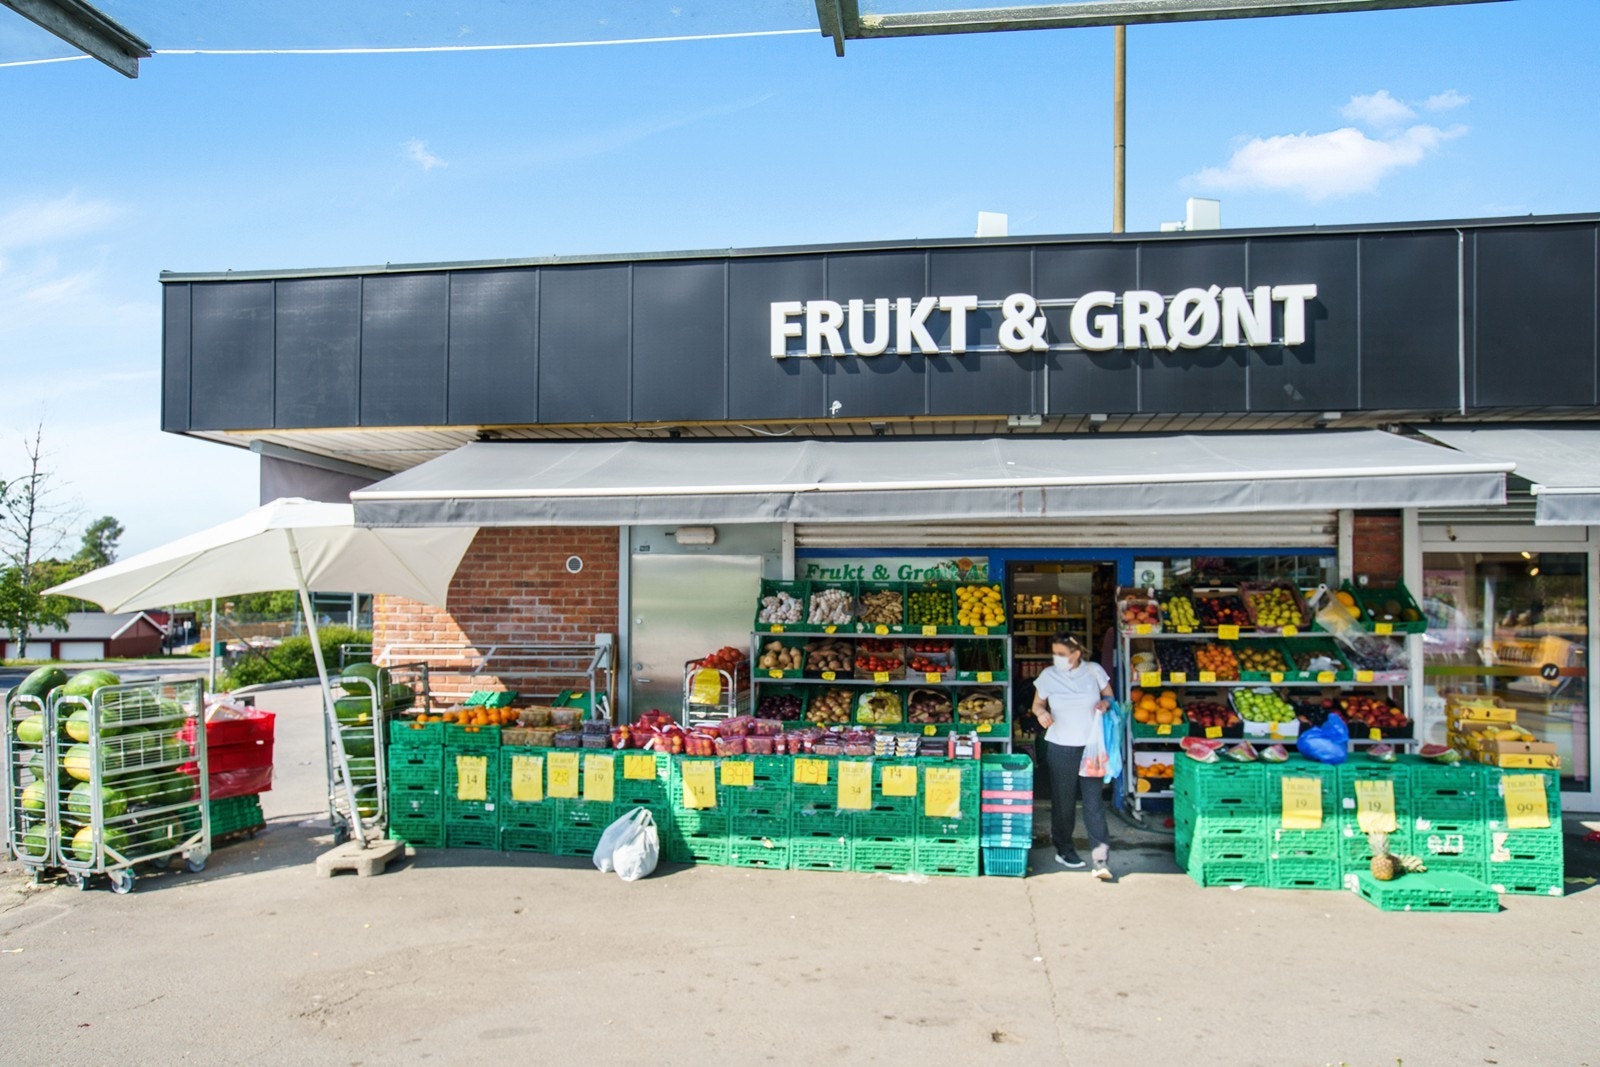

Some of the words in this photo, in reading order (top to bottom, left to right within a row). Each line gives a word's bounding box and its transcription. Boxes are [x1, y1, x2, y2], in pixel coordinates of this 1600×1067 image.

[770, 295, 978, 359] FRUKT
[998, 292, 1050, 354] &
[1069, 284, 1318, 352] GRØNT
[806, 563, 865, 581] Frukt
[872, 564, 890, 581] &
[897, 563, 958, 581] Grønt
[889, 767, 902, 778] 14
[466, 774, 478, 785] 14
[693, 785, 705, 796] 14
[1295, 798, 1308, 808] 19
[1367, 801, 1382, 812] 19
[1516, 802, 1534, 815] 99
